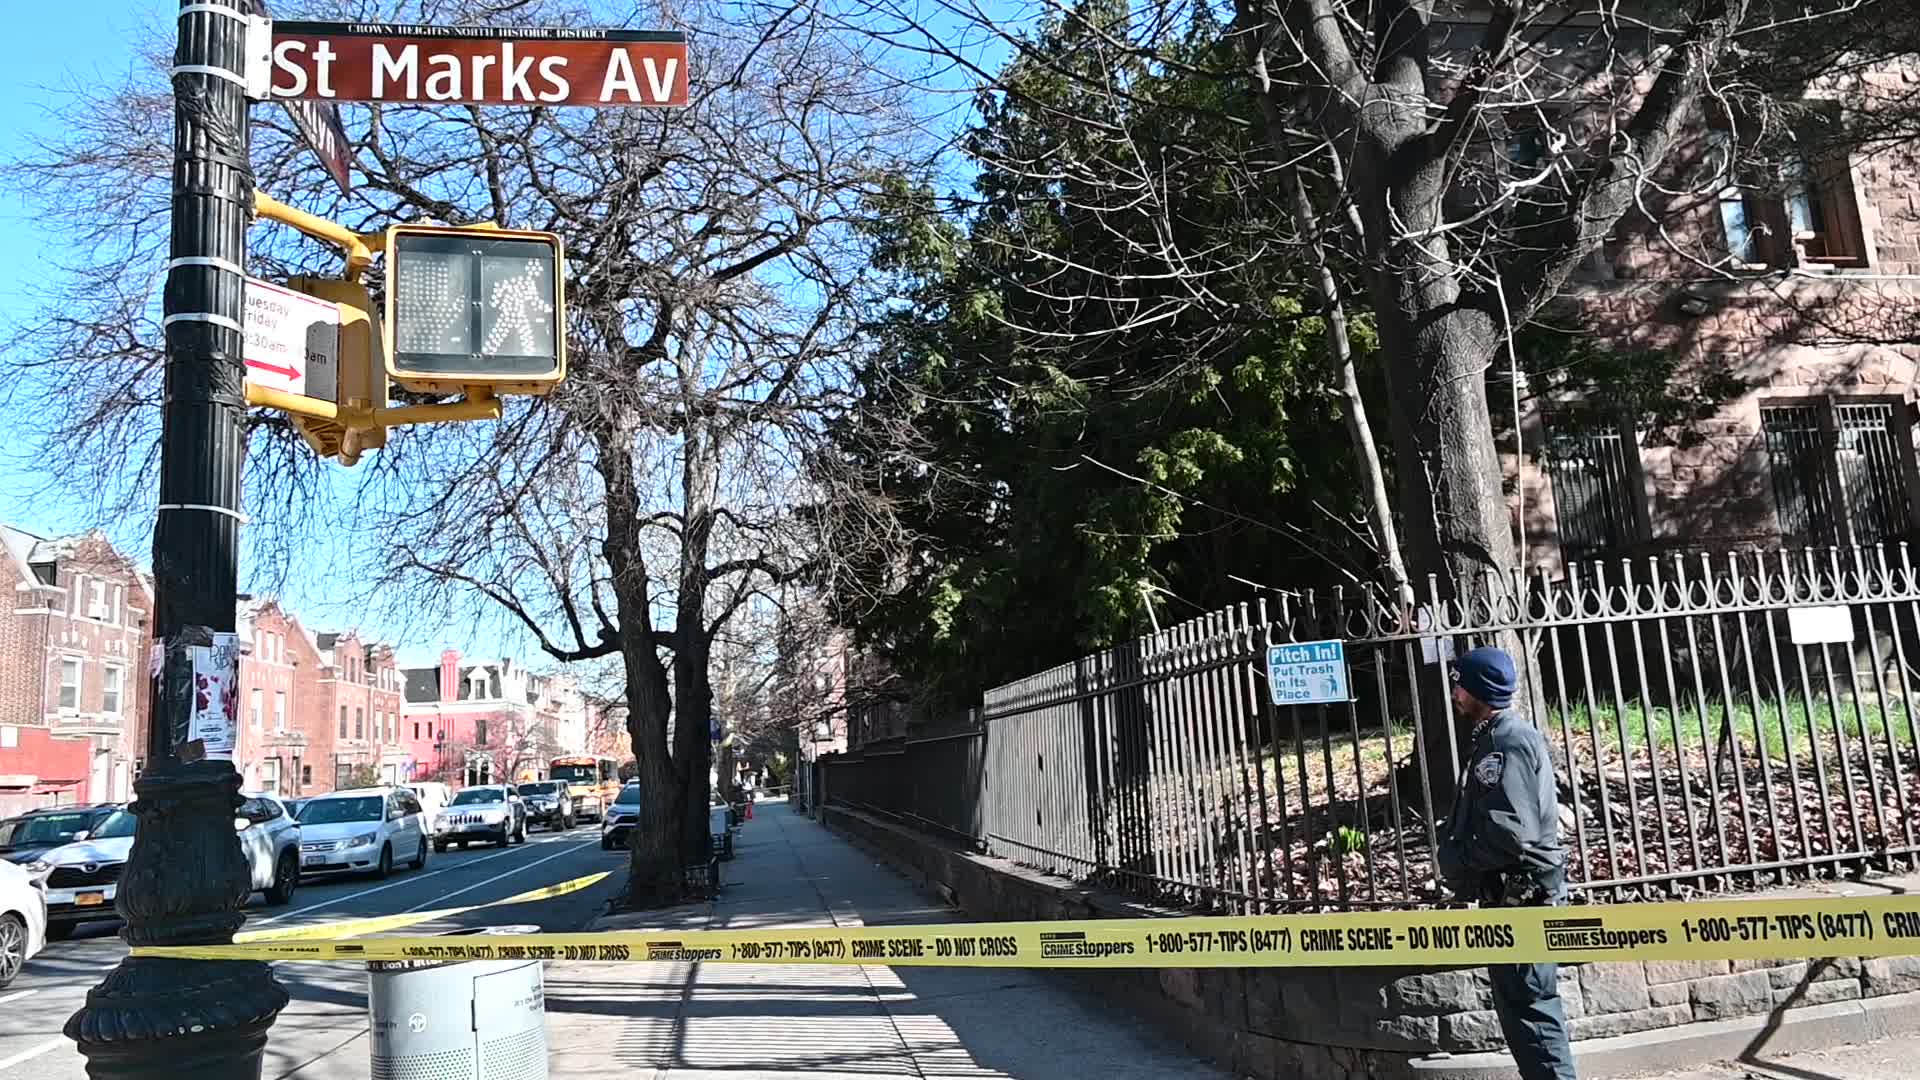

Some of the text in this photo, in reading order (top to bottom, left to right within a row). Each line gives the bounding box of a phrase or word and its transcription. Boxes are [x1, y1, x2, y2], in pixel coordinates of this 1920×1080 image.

[348, 24, 607, 39] CROWN HEIGHTS NORTH HISTORIC DISTRICT
[271, 40, 679, 102] St Marks Av
[246, 296, 290, 319] uesday
[1271, 643, 1337, 664] Pitch In!
[1273, 664, 1334, 677] Put Trash
[1274, 677, 1306, 689] In Its
[1276, 690, 1311, 700] Place
[1145, 929, 1247, 953] 1-800-577-TIPS
[1249, 927, 1291, 953] (8477)
[1300, 928, 1345, 952] CRIME
[1347, 928, 1393, 951] SCENE
[1408, 926, 1429, 950] DO
[1432, 925, 1460, 950] NOT
[1464, 924, 1515, 949] CROSS
[1548, 928, 1668, 949] CRIMEstoppers
[1681, 914, 1816, 943] 1-800-577-TIPS
[1817, 910, 1874, 941] (8477)
[599, 944, 630, 960] CROSS
[812, 939, 846, 960] (8477)
[852, 940, 886, 958] CRIME
[888, 939, 924, 957] SCENE
[936, 938, 951, 957] DO
[954, 938, 977, 957] NOT
[979, 936, 1018, 956] CROSS
